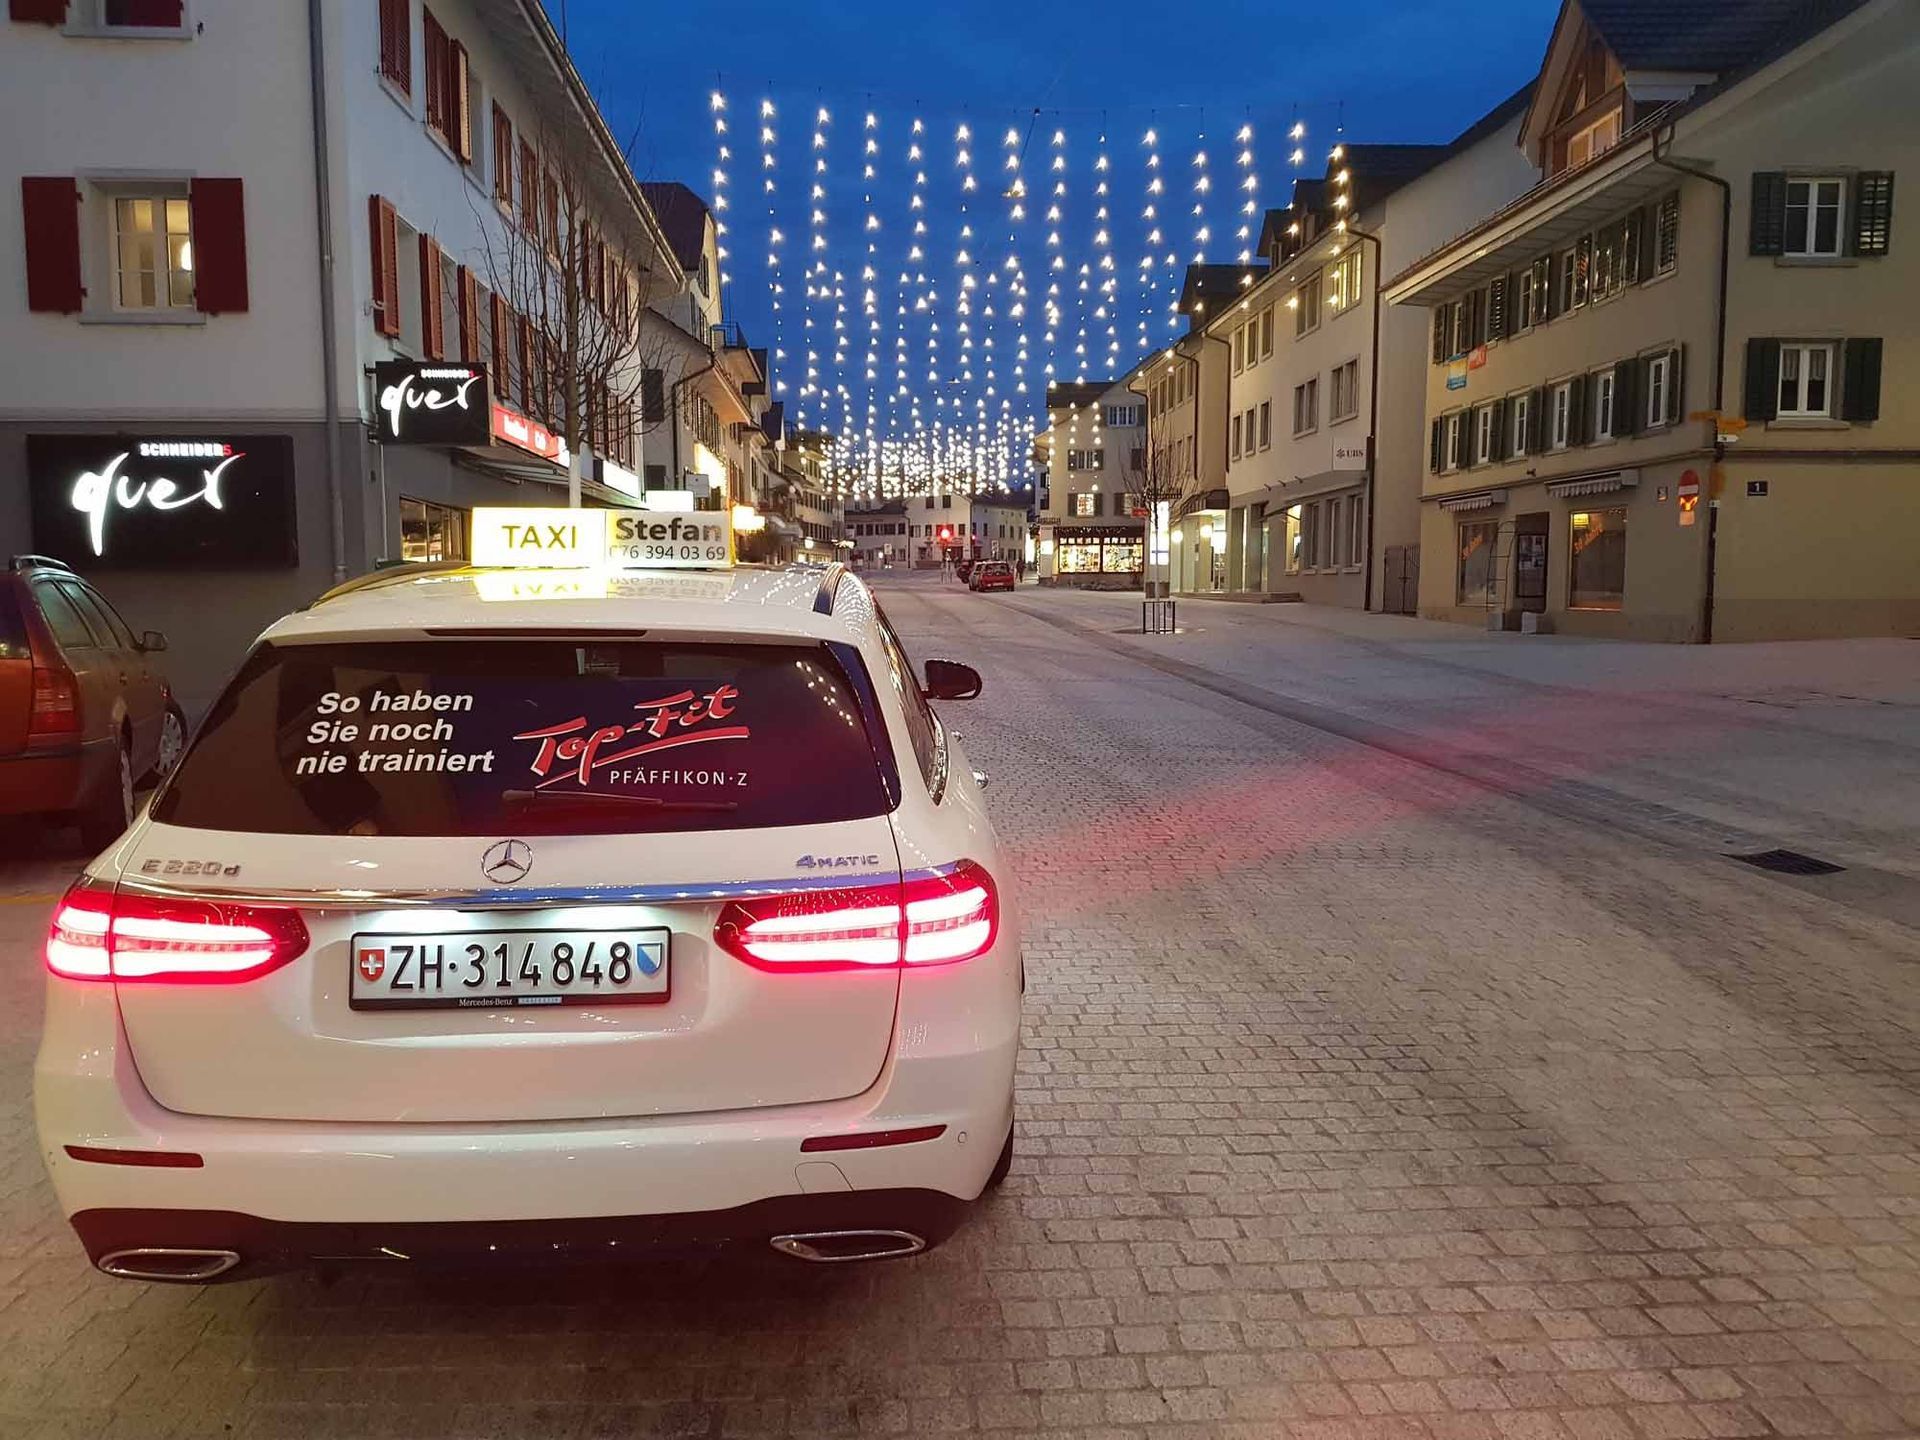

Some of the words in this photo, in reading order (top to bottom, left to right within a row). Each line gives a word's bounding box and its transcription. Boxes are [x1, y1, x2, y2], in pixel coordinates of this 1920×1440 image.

[380, 374, 482, 437] quer
[1346, 449, 1364, 457] UBS
[71, 452, 246, 556] quer
[501, 525, 577, 549] TAXI
[616, 517, 722, 542] Stefan
[645, 545, 674, 560] 394
[680, 546, 700, 560] 03
[706, 546, 726, 560] 69
[317, 692, 361, 715] So
[369, 690, 474, 712] haben
[306, 720, 359, 744] Sie
[368, 718, 454, 741] noch
[296, 751, 347, 775] nie
[357, 748, 495, 773] trainiert
[796, 854, 880, 869] 4MATIC
[458, 997, 513, 1007] Mercedes-Benz
